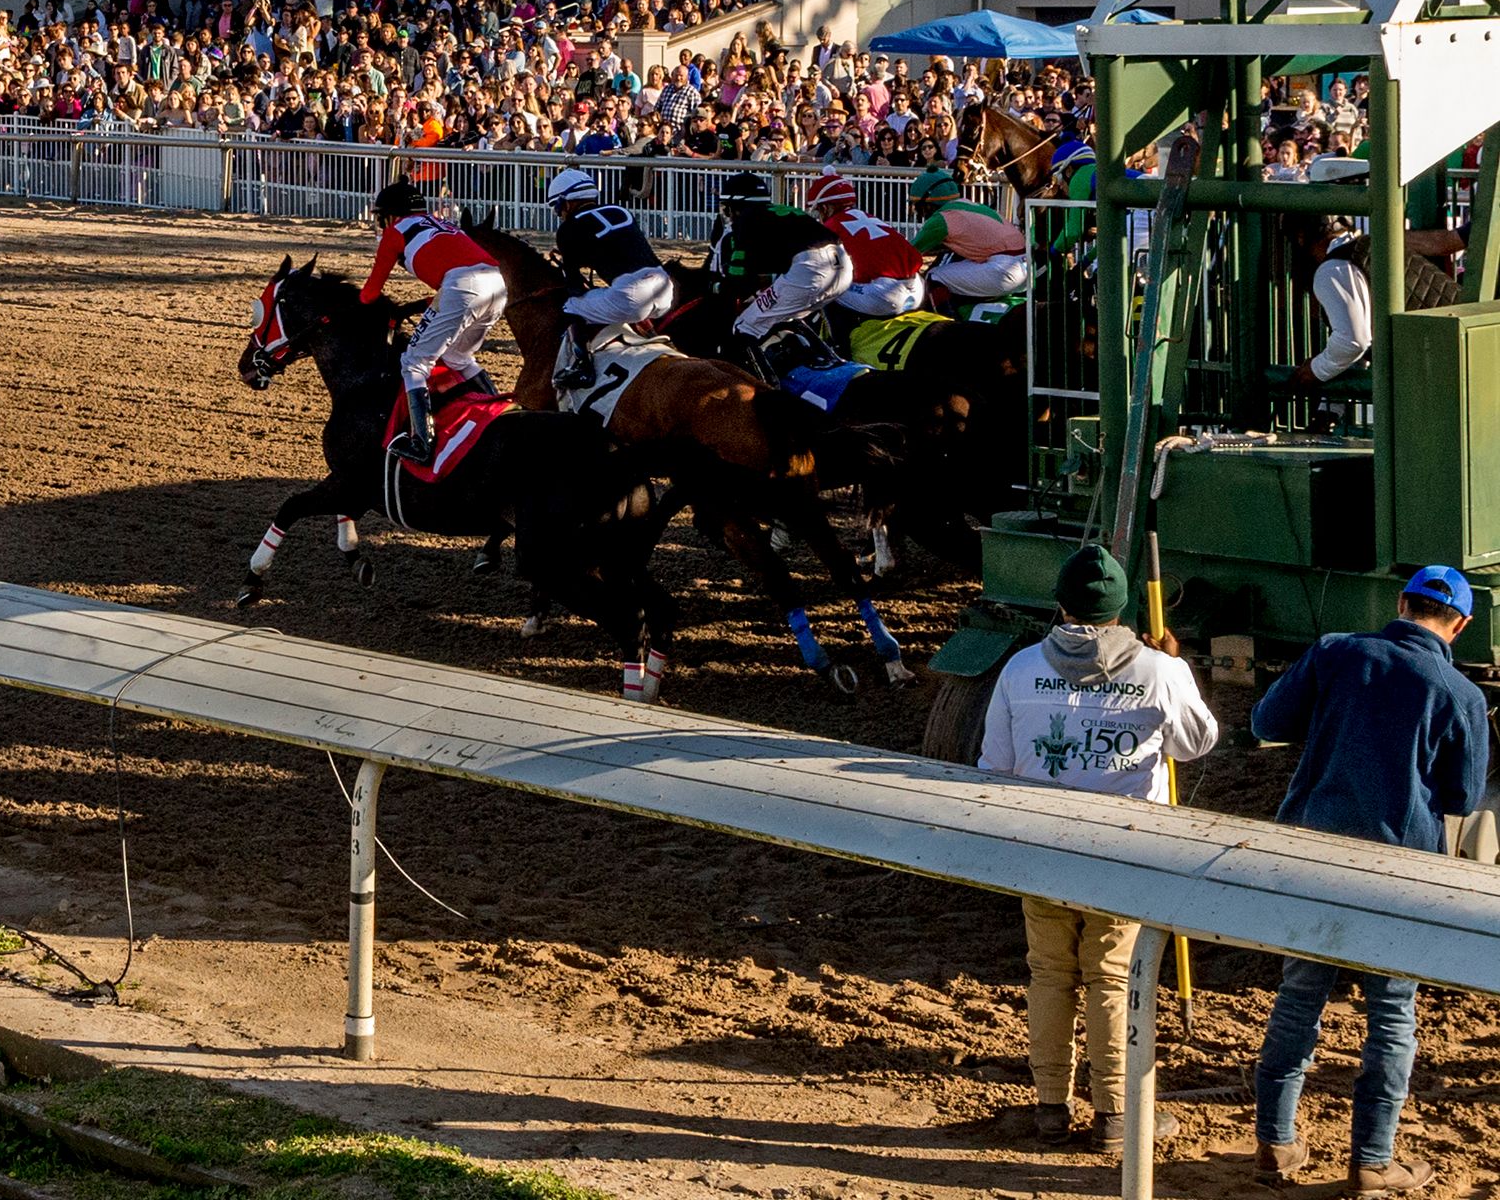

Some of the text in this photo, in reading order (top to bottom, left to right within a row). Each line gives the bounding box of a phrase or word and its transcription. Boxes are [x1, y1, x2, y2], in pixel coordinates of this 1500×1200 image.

[877, 326, 918, 370] 4
[577, 362, 629, 420] 2
[433, 419, 477, 474] 1
[1035, 678, 1067, 690] FAIR
[1069, 682, 1145, 697] GROUNDS
[1081, 718, 1146, 731] CELEBRATING
[1083, 727, 1139, 757] 150
[1079, 753, 1140, 772] YEARS
